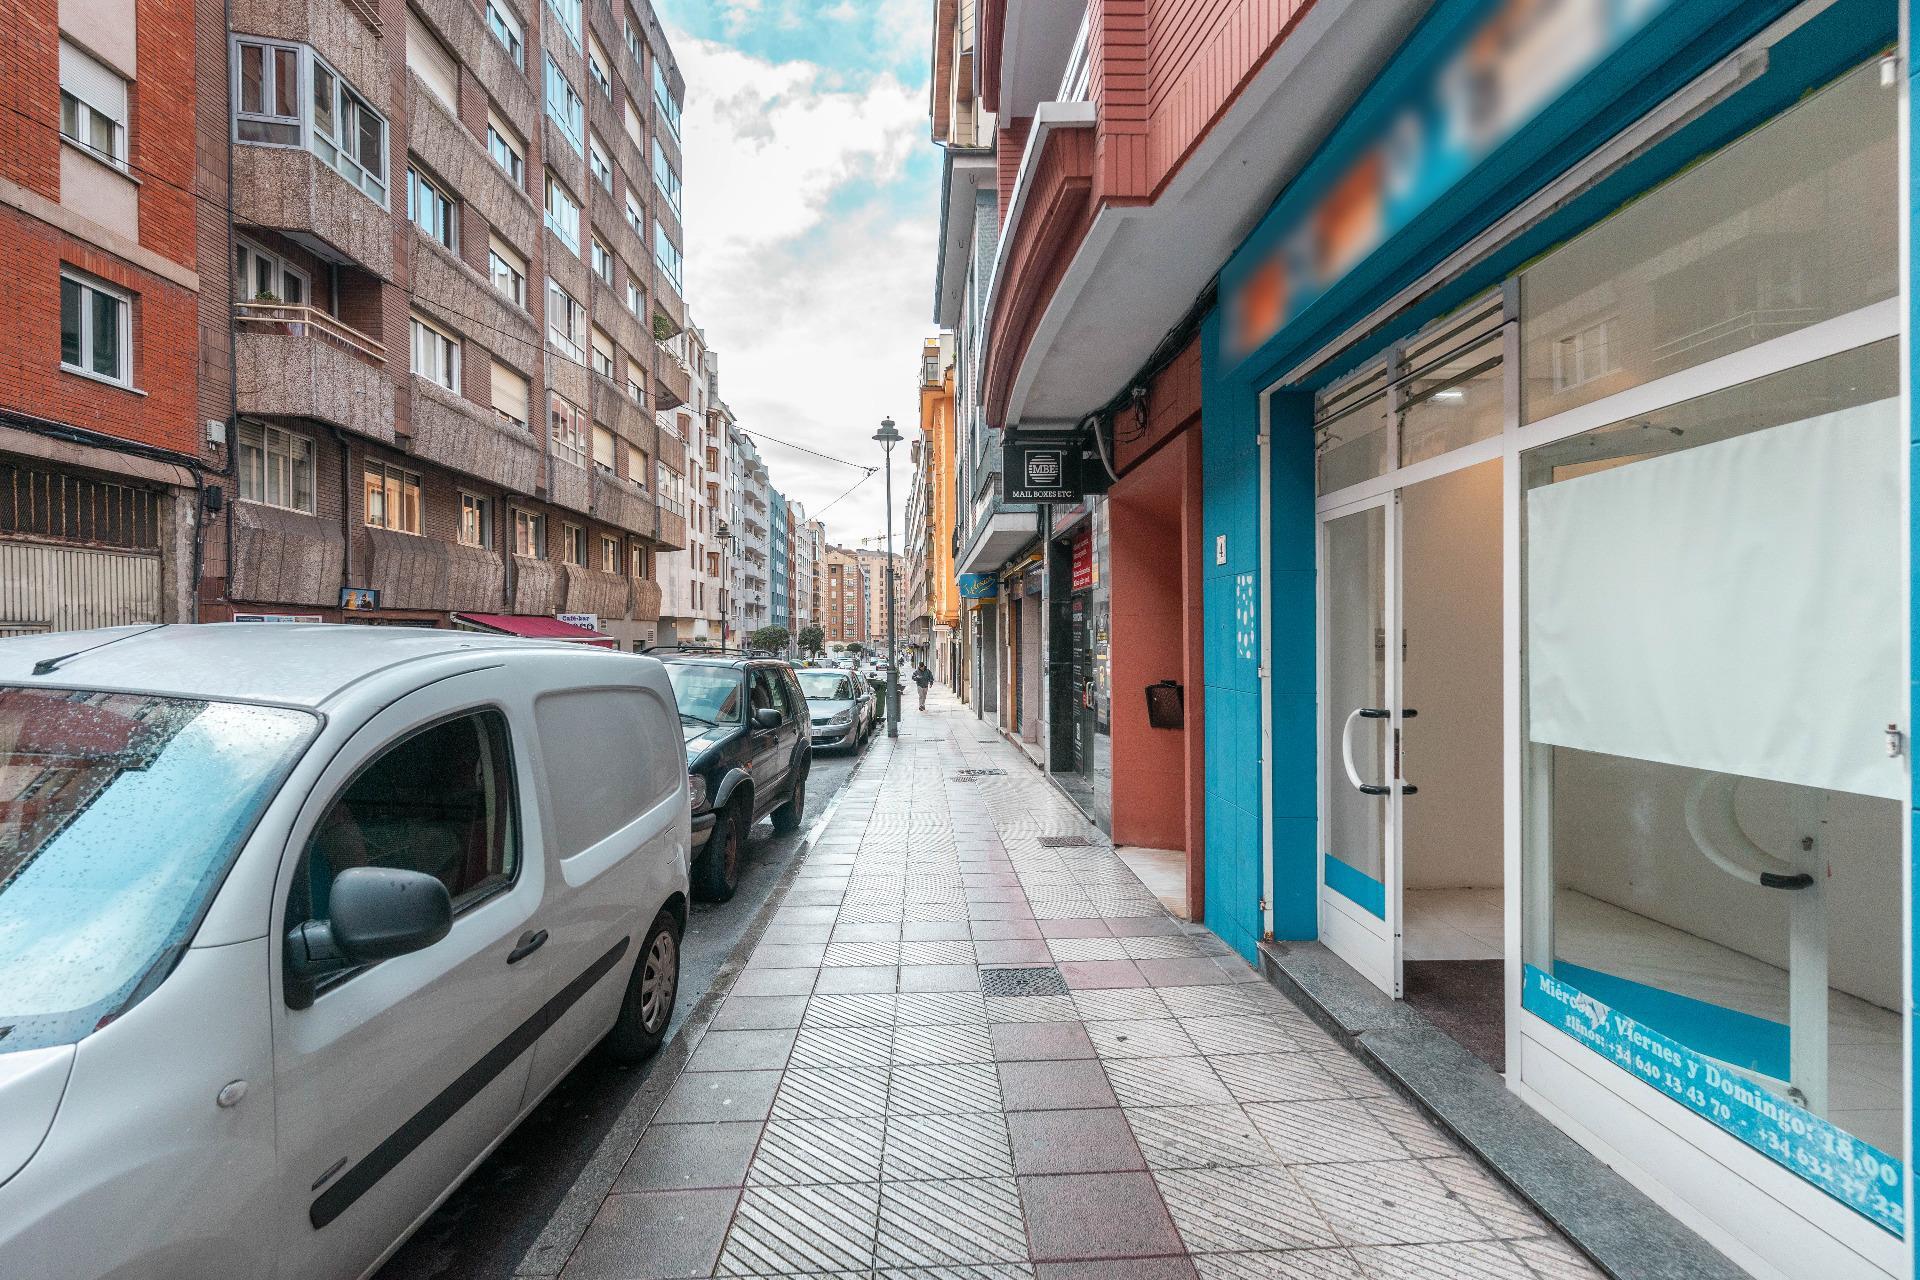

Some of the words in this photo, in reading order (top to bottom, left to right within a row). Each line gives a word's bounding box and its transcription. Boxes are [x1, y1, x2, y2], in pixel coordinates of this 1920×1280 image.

[1032, 464, 1056, 474] MBE
[1012, 490, 1032, 498] MAIL
[1033, 490, 1057, 498] BOXES
[1614, 1015, 1682, 1068] Viernes
[1686, 1058, 1699, 1080] y
[1608, 1043, 1632, 1065] +34
[1635, 1054, 1661, 1080] 640
[1664, 1073, 1683, 1094] 13
[1686, 1085, 1706, 1107] 43
[1710, 1097, 1731, 1120] 70
